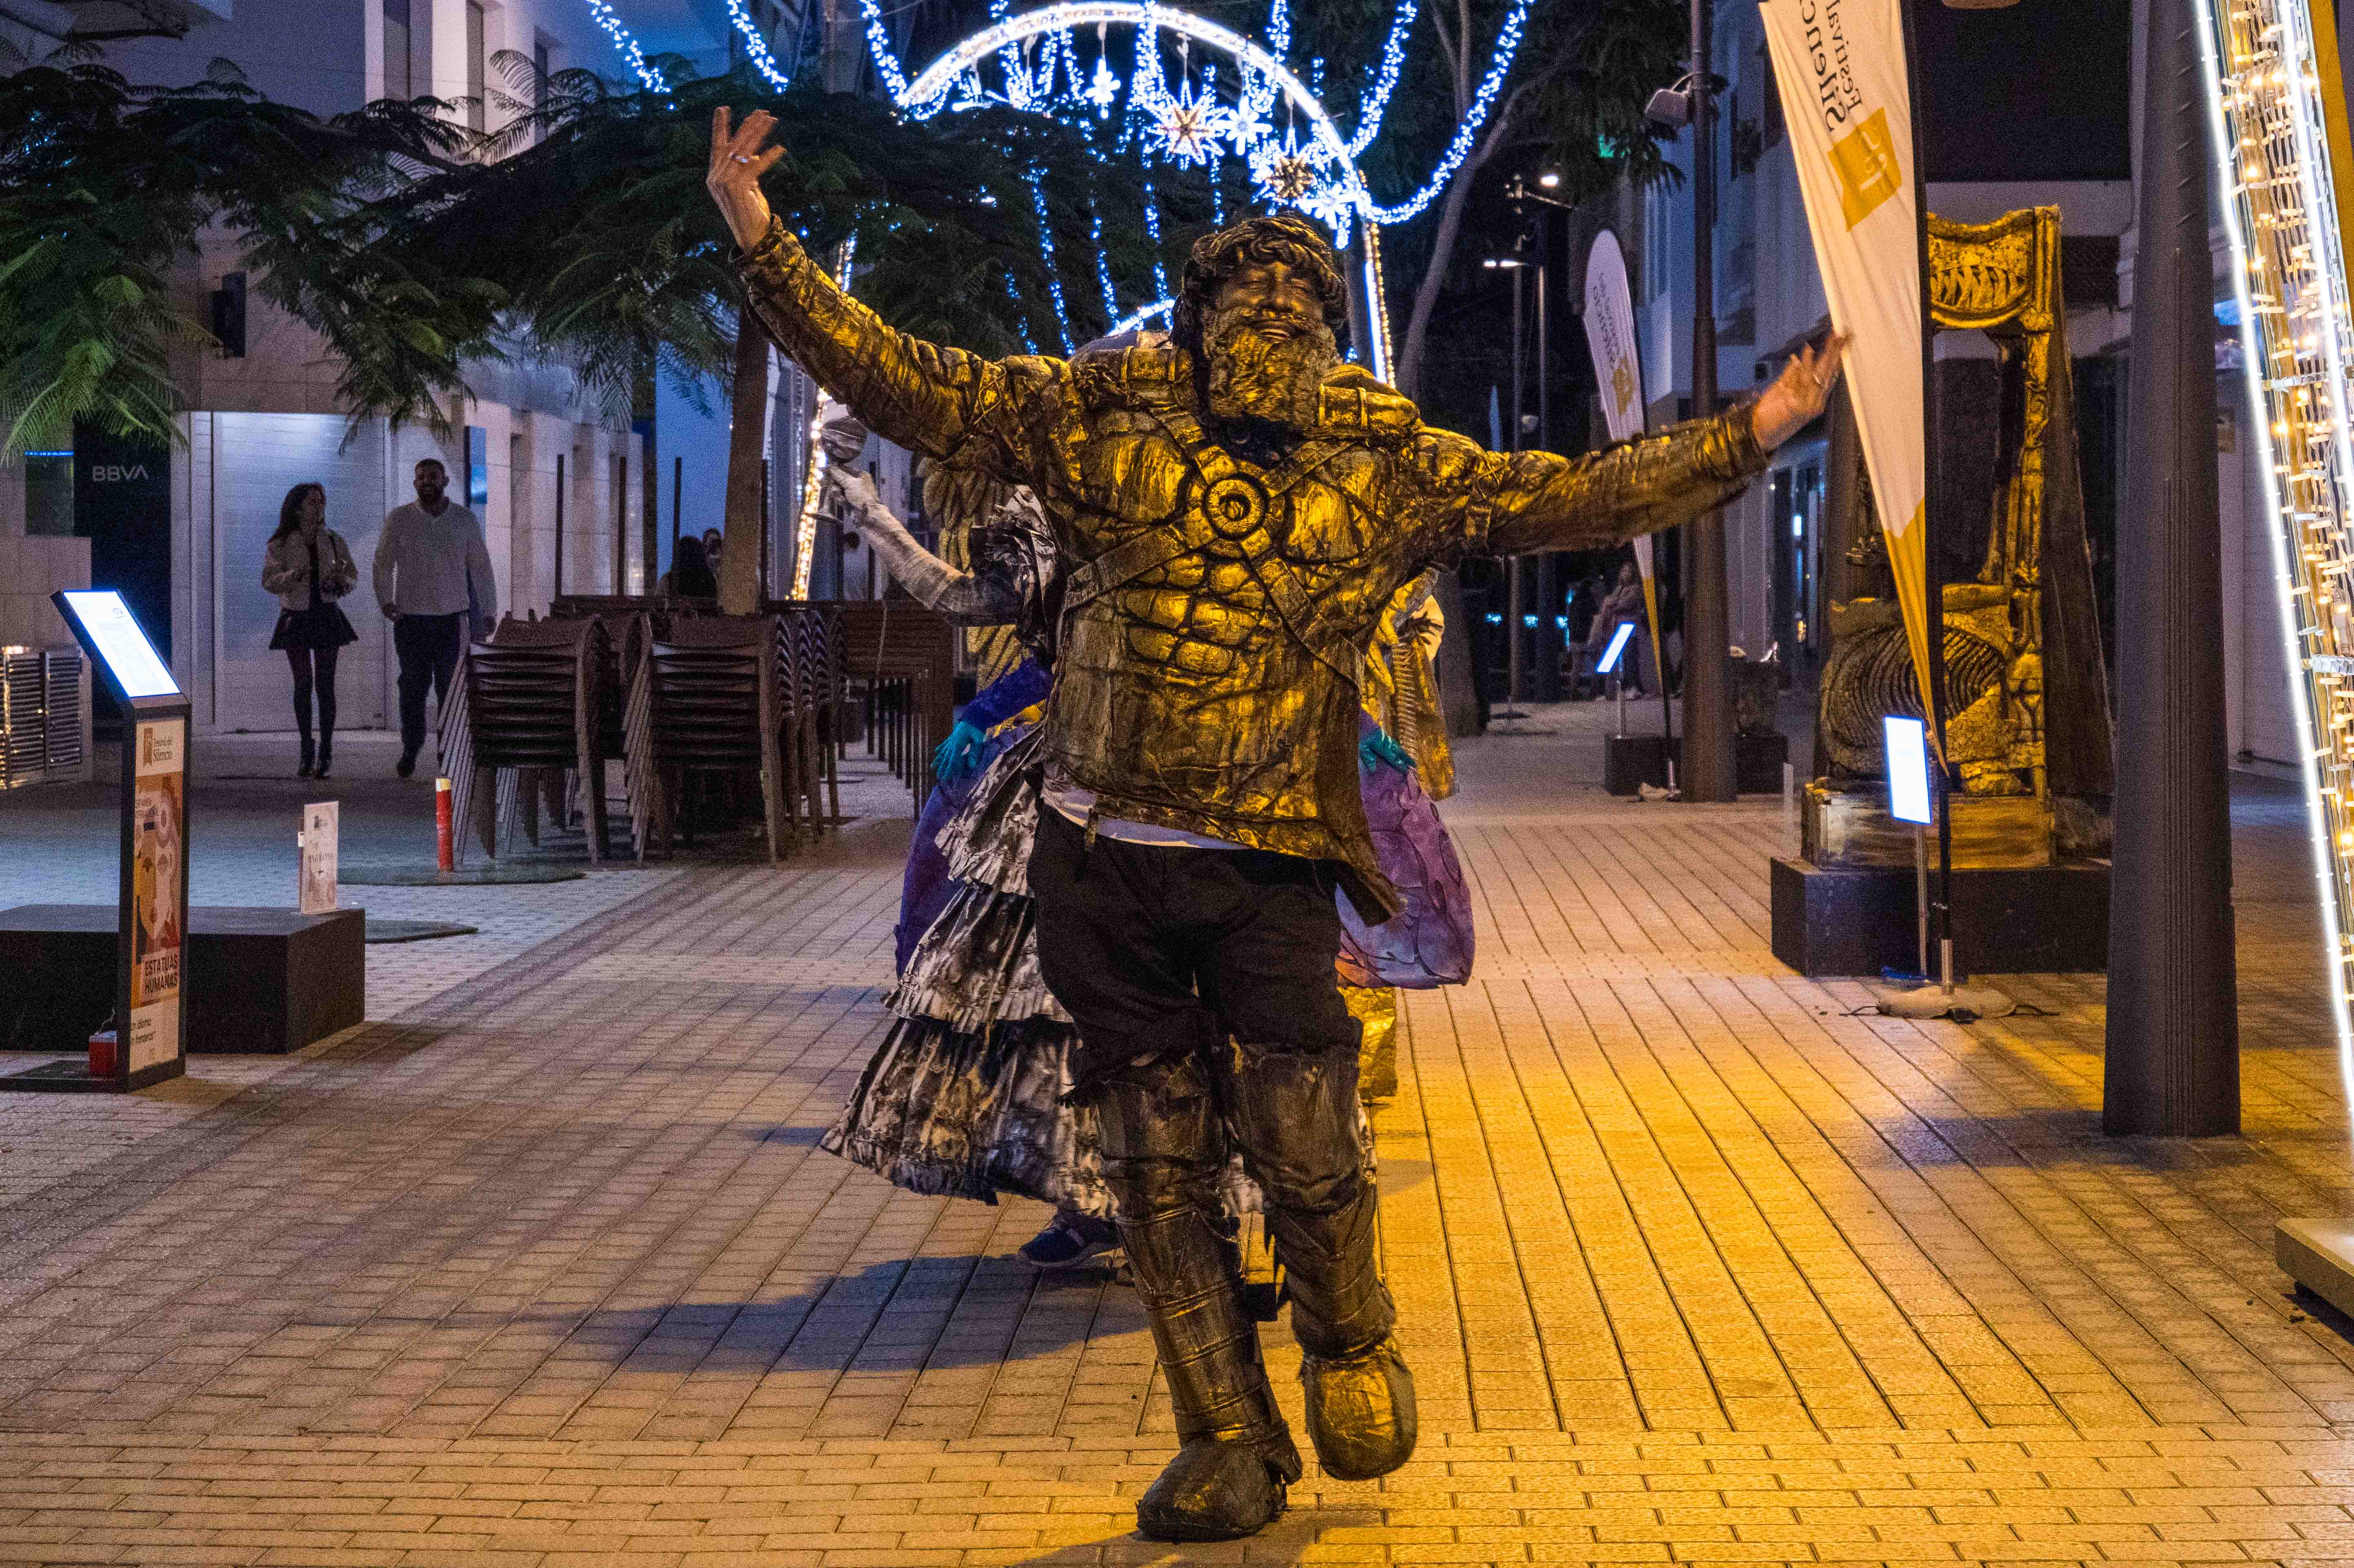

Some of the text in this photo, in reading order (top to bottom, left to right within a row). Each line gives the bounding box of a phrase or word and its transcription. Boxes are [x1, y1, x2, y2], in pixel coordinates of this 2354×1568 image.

[92, 465, 149, 482] BBVA
[153, 748, 173, 762] Silencio
[144, 953, 178, 976] ESTATUAS
[144, 972, 178, 995] HUMANAS
